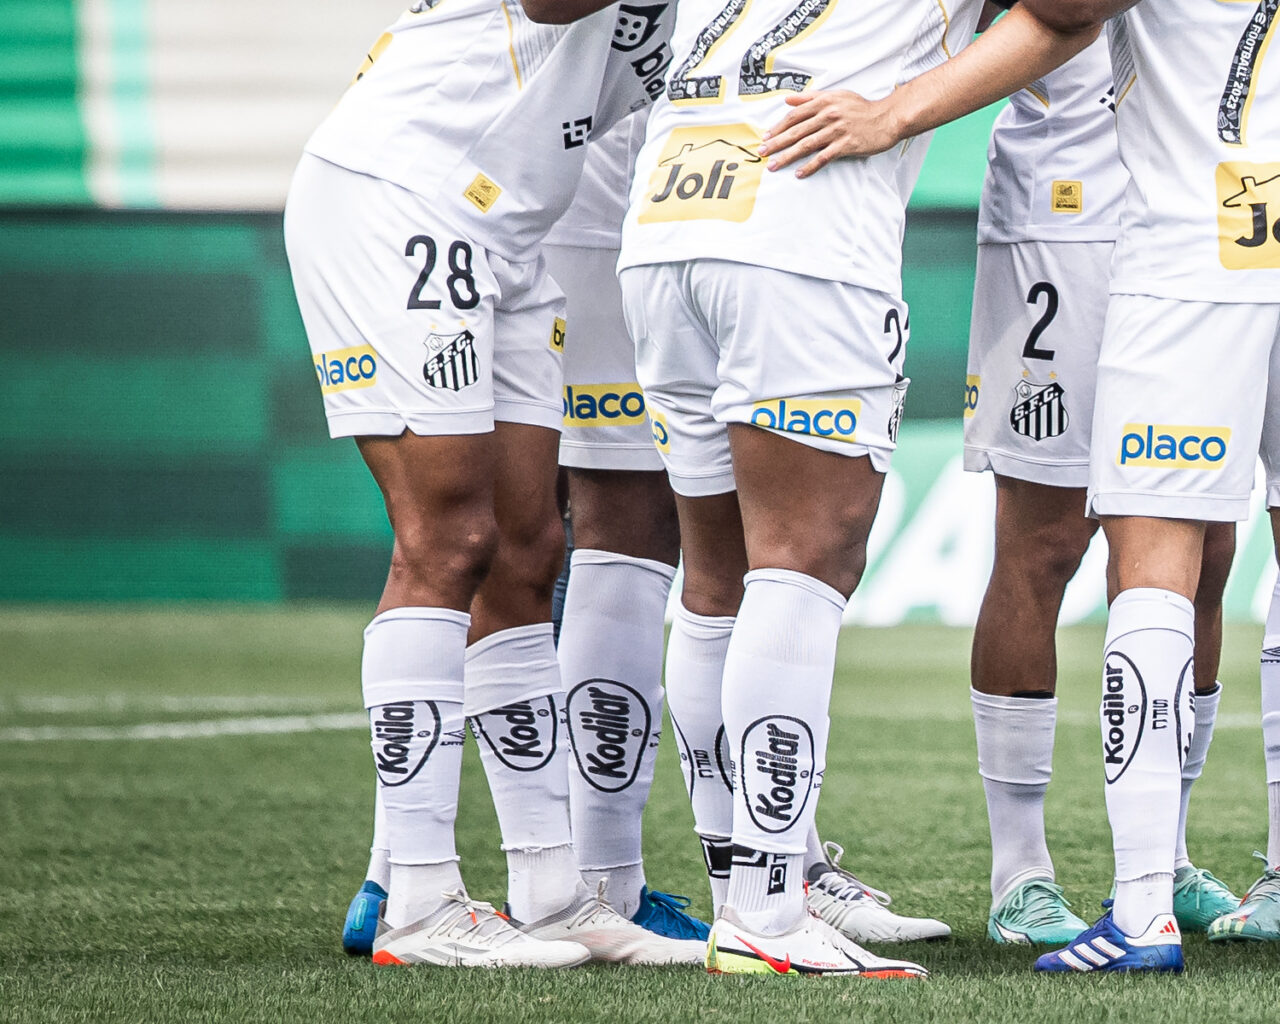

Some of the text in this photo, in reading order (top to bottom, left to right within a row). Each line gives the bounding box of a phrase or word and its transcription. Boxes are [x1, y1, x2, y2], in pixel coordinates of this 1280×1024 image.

[1226, 81, 1244, 110] 2023
[650, 158, 740, 204] Joli
[404, 234, 481, 311] 28
[1022, 281, 1059, 361] 2
[317, 353, 377, 387] laco
[563, 386, 646, 420] laco
[1120, 424, 1227, 465] placo
[579, 686, 630, 779] Kodilar
[1103, 662, 1126, 765] Kodilar
[755, 723, 800, 822] Kodilar
